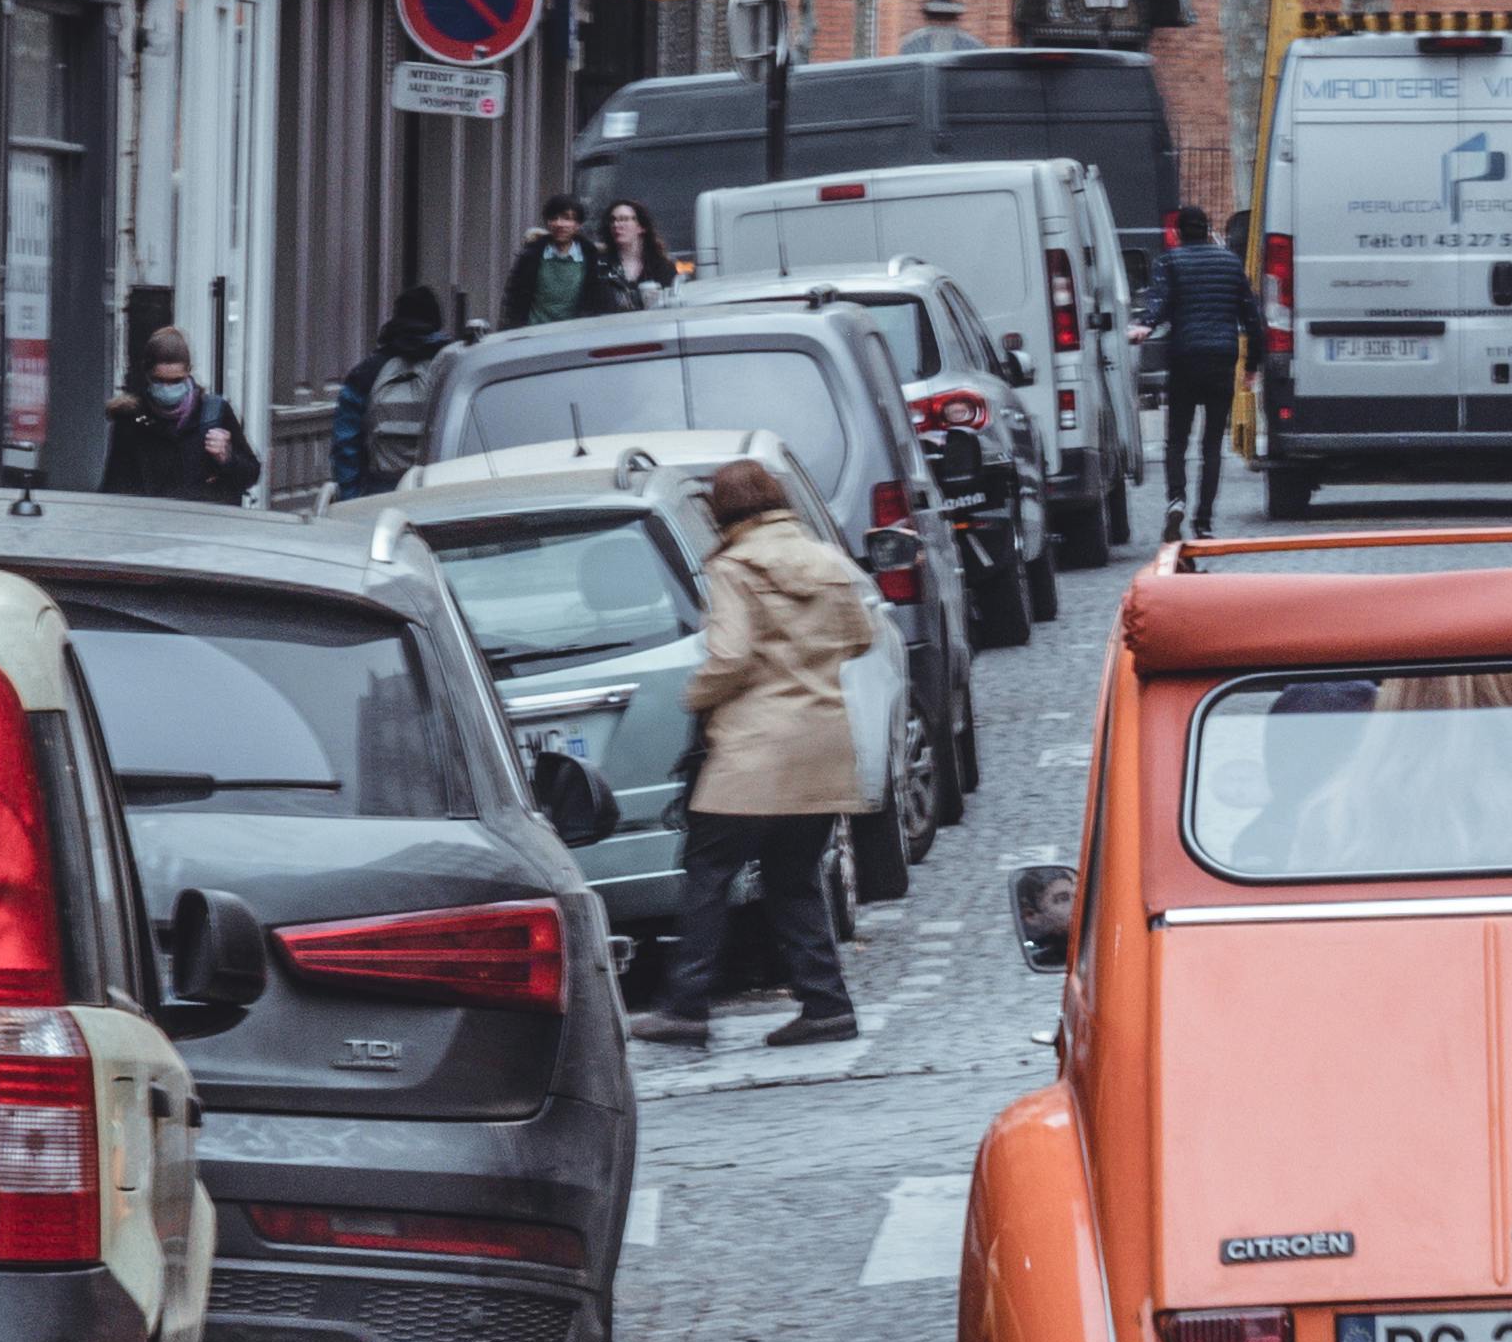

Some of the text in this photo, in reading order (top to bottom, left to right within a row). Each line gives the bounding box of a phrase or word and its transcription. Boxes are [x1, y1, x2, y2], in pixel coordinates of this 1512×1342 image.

[1302, 77, 1461, 100] MIROITERIE
[343, 1039, 402, 1059] TDI
[1226, 1232, 1350, 1260] CITROËN
